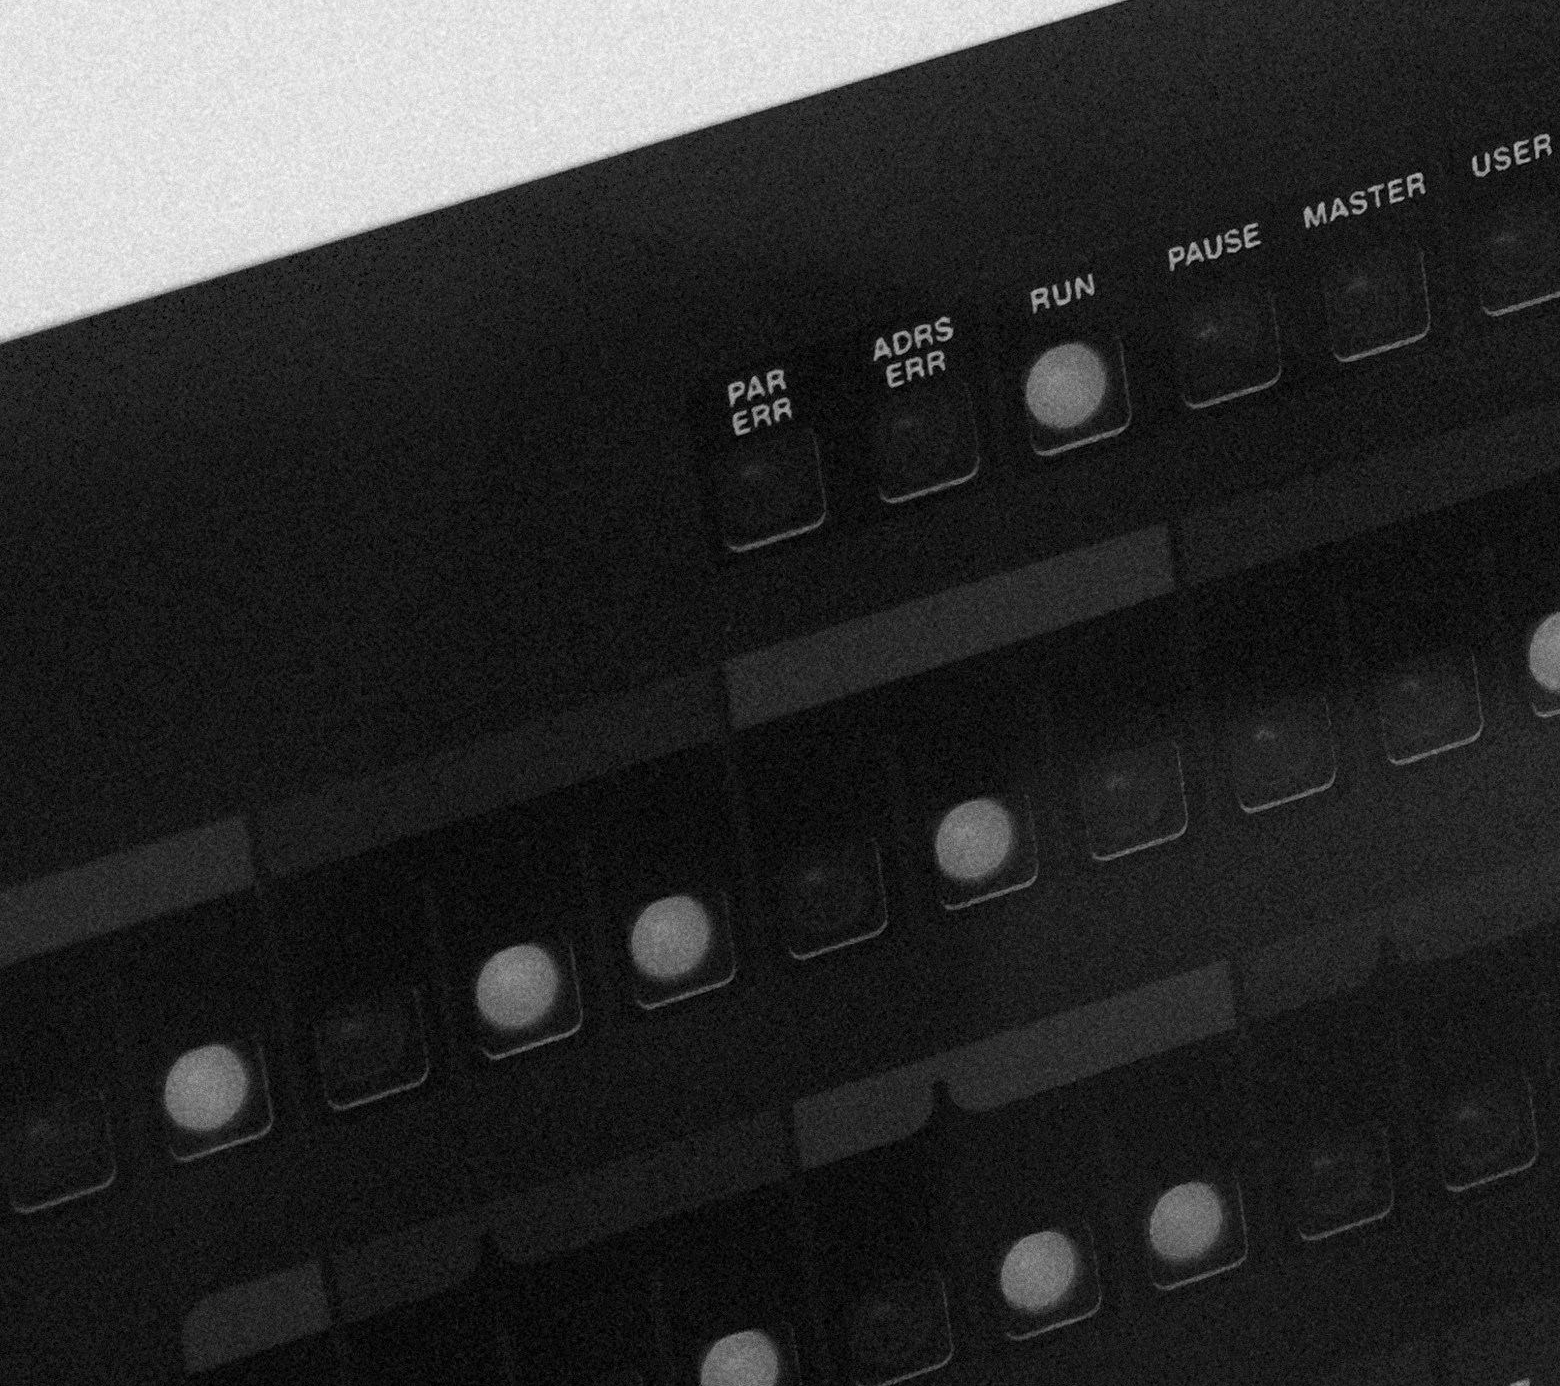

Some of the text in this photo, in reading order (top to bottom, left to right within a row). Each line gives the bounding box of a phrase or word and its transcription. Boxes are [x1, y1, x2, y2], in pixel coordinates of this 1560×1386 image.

[1470, 132, 1553, 178] USER
[1302, 171, 1427, 229] MASTER
[1167, 221, 1261, 271] PAUSE
[1029, 273, 1096, 313] RUN
[873, 317, 954, 360] ADRS
[727, 368, 787, 407] PAR
[885, 350, 946, 388] ERR
[732, 397, 792, 436] ERR
